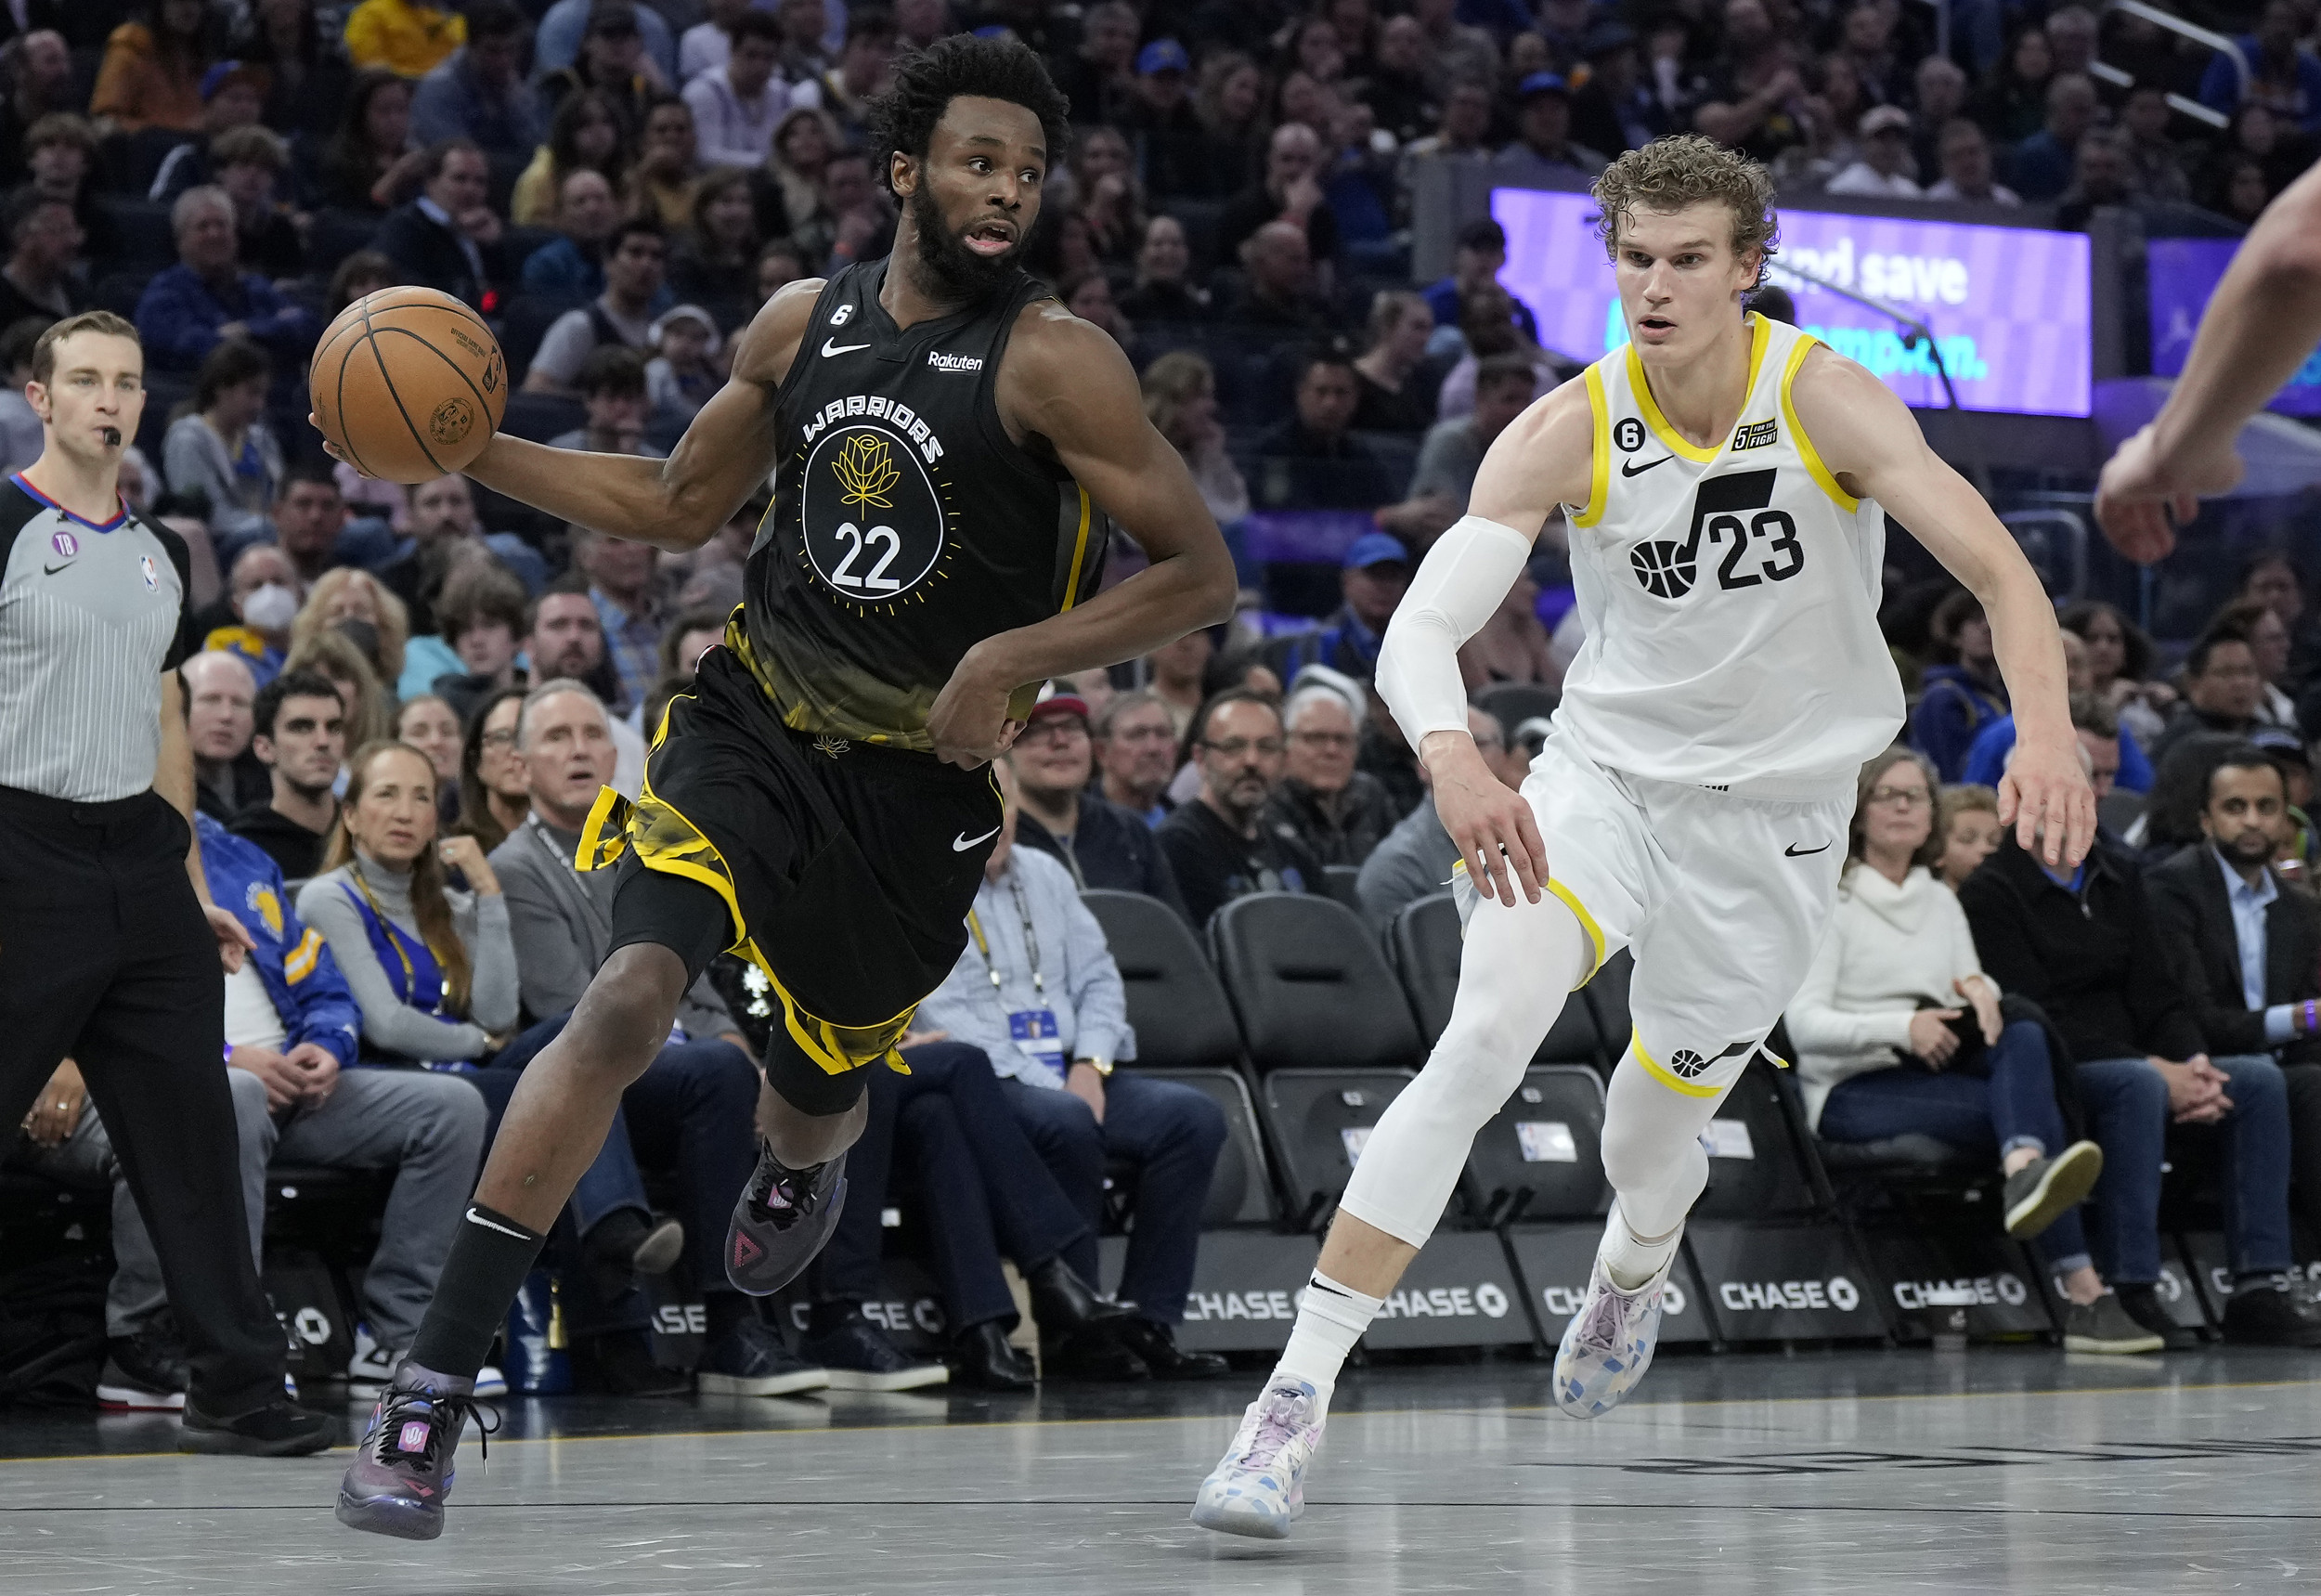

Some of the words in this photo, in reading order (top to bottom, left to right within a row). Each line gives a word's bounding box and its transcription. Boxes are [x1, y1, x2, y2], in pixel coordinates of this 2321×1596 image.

[1860, 251, 1966, 305] save
[829, 305, 853, 326] 6
[928, 351, 983, 371] Rakuten
[803, 396, 944, 464] WARRIORS
[1621, 422, 1640, 448] 6
[1735, 428, 1748, 448] 5
[1750, 432, 1776, 447] FIGHT
[55, 534, 74, 556] TB
[832, 522, 901, 590] 22
[1708, 510, 1805, 590] 23
[1374, 1287, 1478, 1318] HASE
[1719, 1280, 1830, 1311] CHASE
